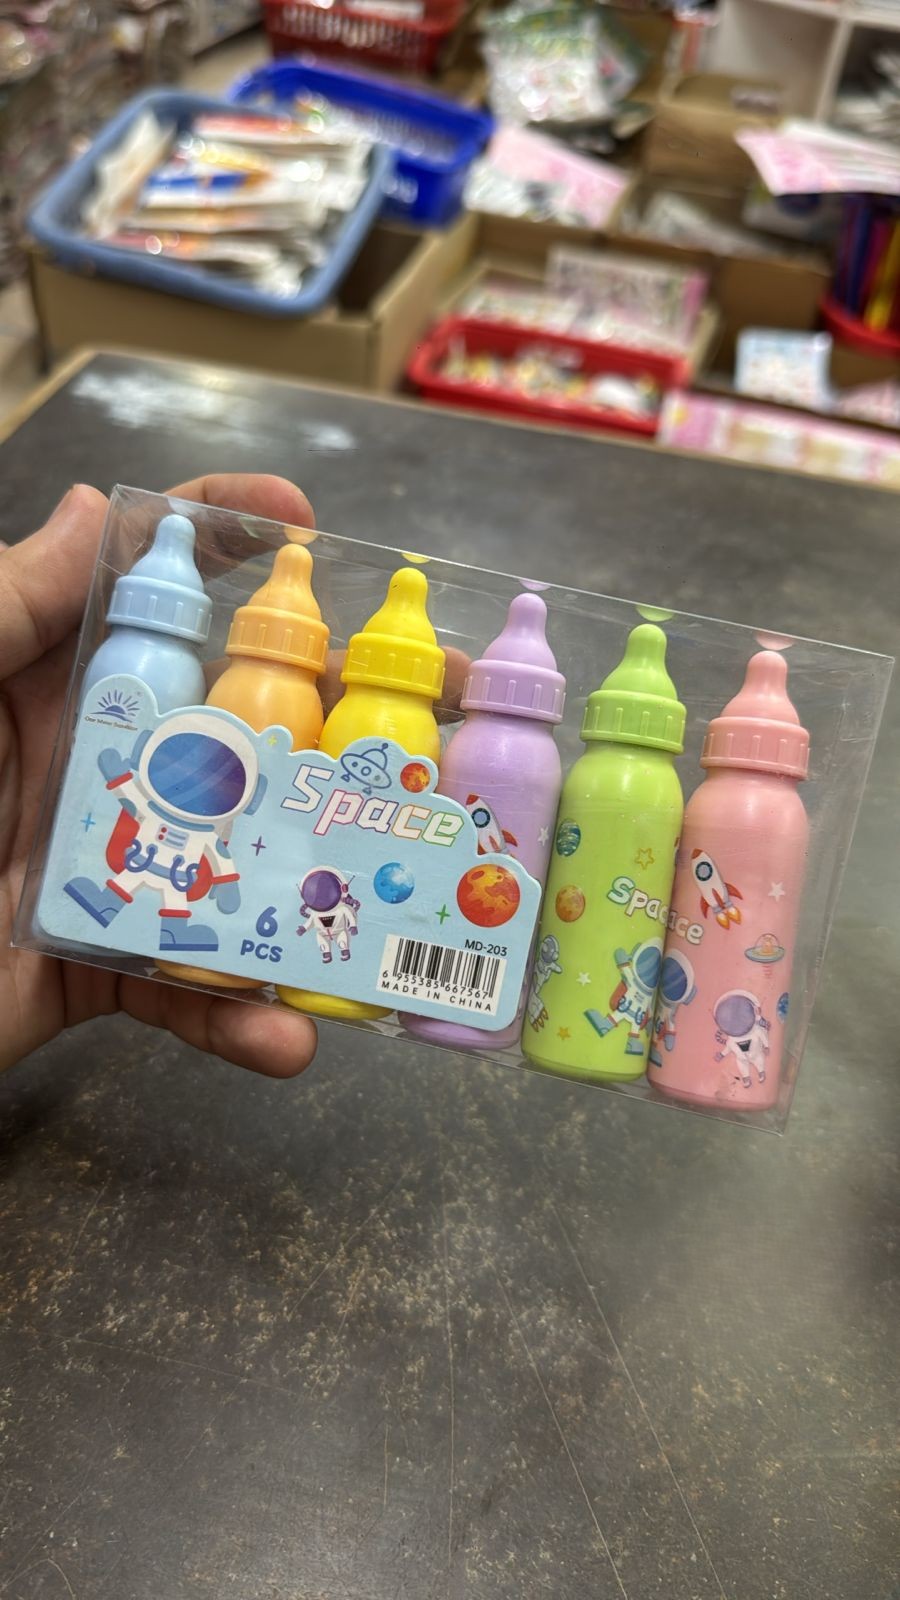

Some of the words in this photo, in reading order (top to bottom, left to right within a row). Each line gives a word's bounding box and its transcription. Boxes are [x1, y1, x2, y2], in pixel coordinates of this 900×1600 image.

[280, 764, 465, 848] Space
[255, 906, 278, 938] 6
[240, 939, 283, 963] PCS
[464, 939, 508, 957] MD-203
[381, 981, 418, 995] MADE
[426, 990, 441, 1000] IN
[449, 995, 491, 1012] CHINA
[382, 969, 389, 978] 6
[396, 972, 439, 989] 955385
[444, 983, 489, 1000] 667567
